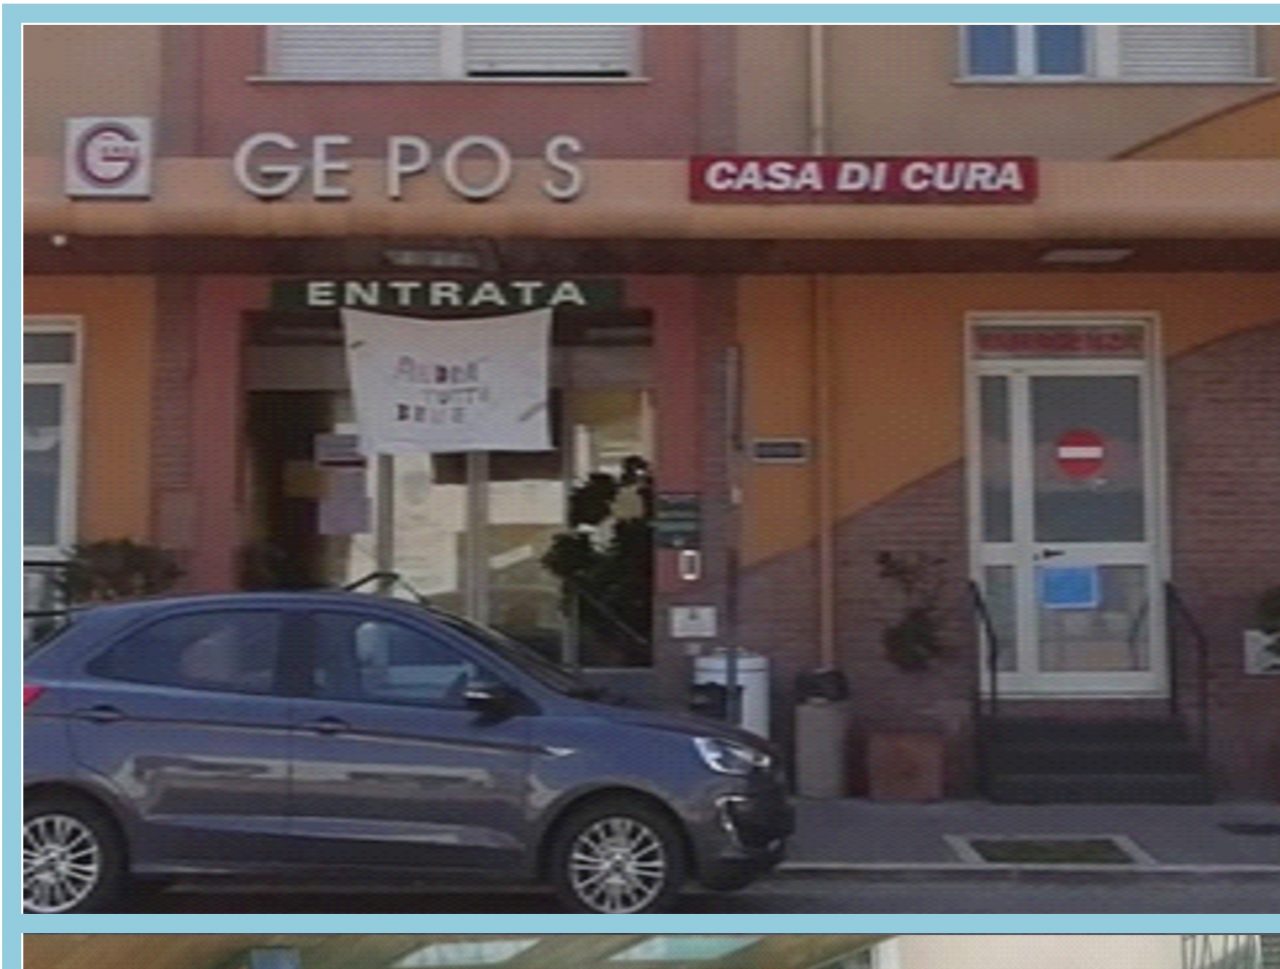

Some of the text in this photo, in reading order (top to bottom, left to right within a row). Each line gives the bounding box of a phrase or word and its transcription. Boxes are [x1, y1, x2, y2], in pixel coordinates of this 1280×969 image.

[705, 161, 1025, 192] CASA DI CURA
[307, 281, 587, 307] ENTRATA
